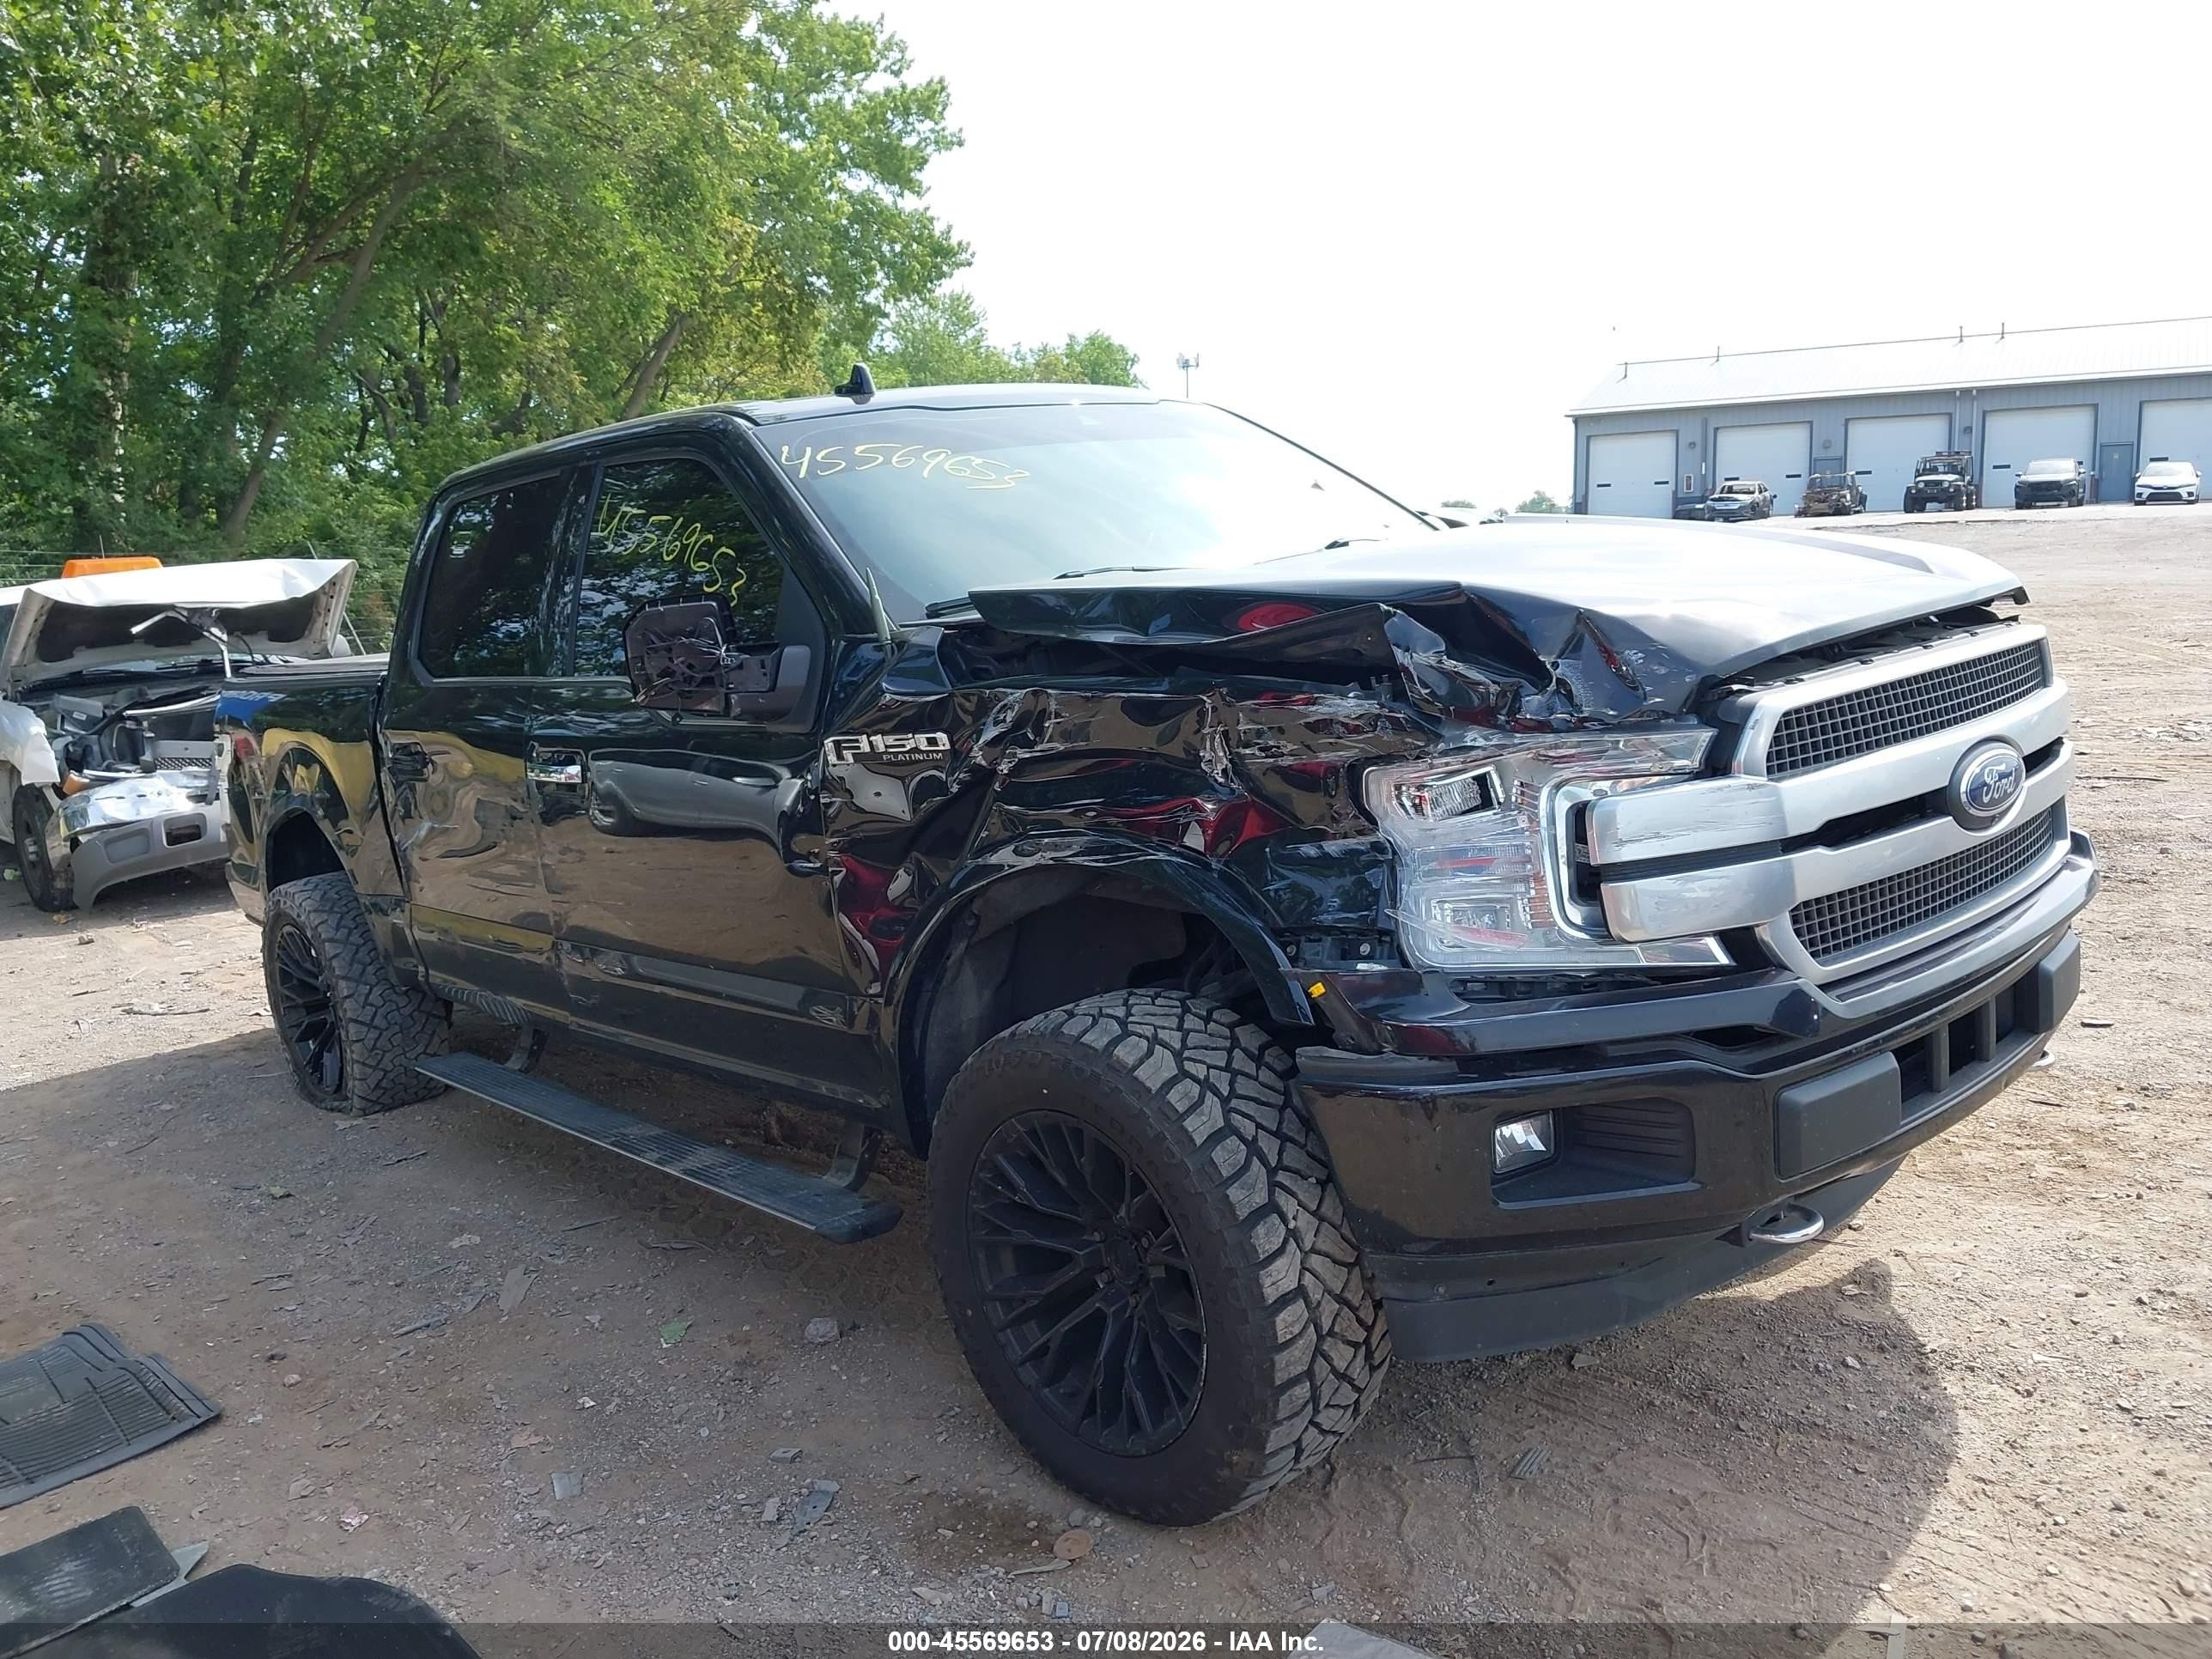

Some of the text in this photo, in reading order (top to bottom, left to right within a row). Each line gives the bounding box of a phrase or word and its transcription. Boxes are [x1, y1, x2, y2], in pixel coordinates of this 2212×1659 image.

[781, 442, 1031, 489] 45569653
[591, 492, 747, 607] 45569653
[882, 752, 944, 763] PLATINUM
[1982, 763, 2020, 804] Ford
